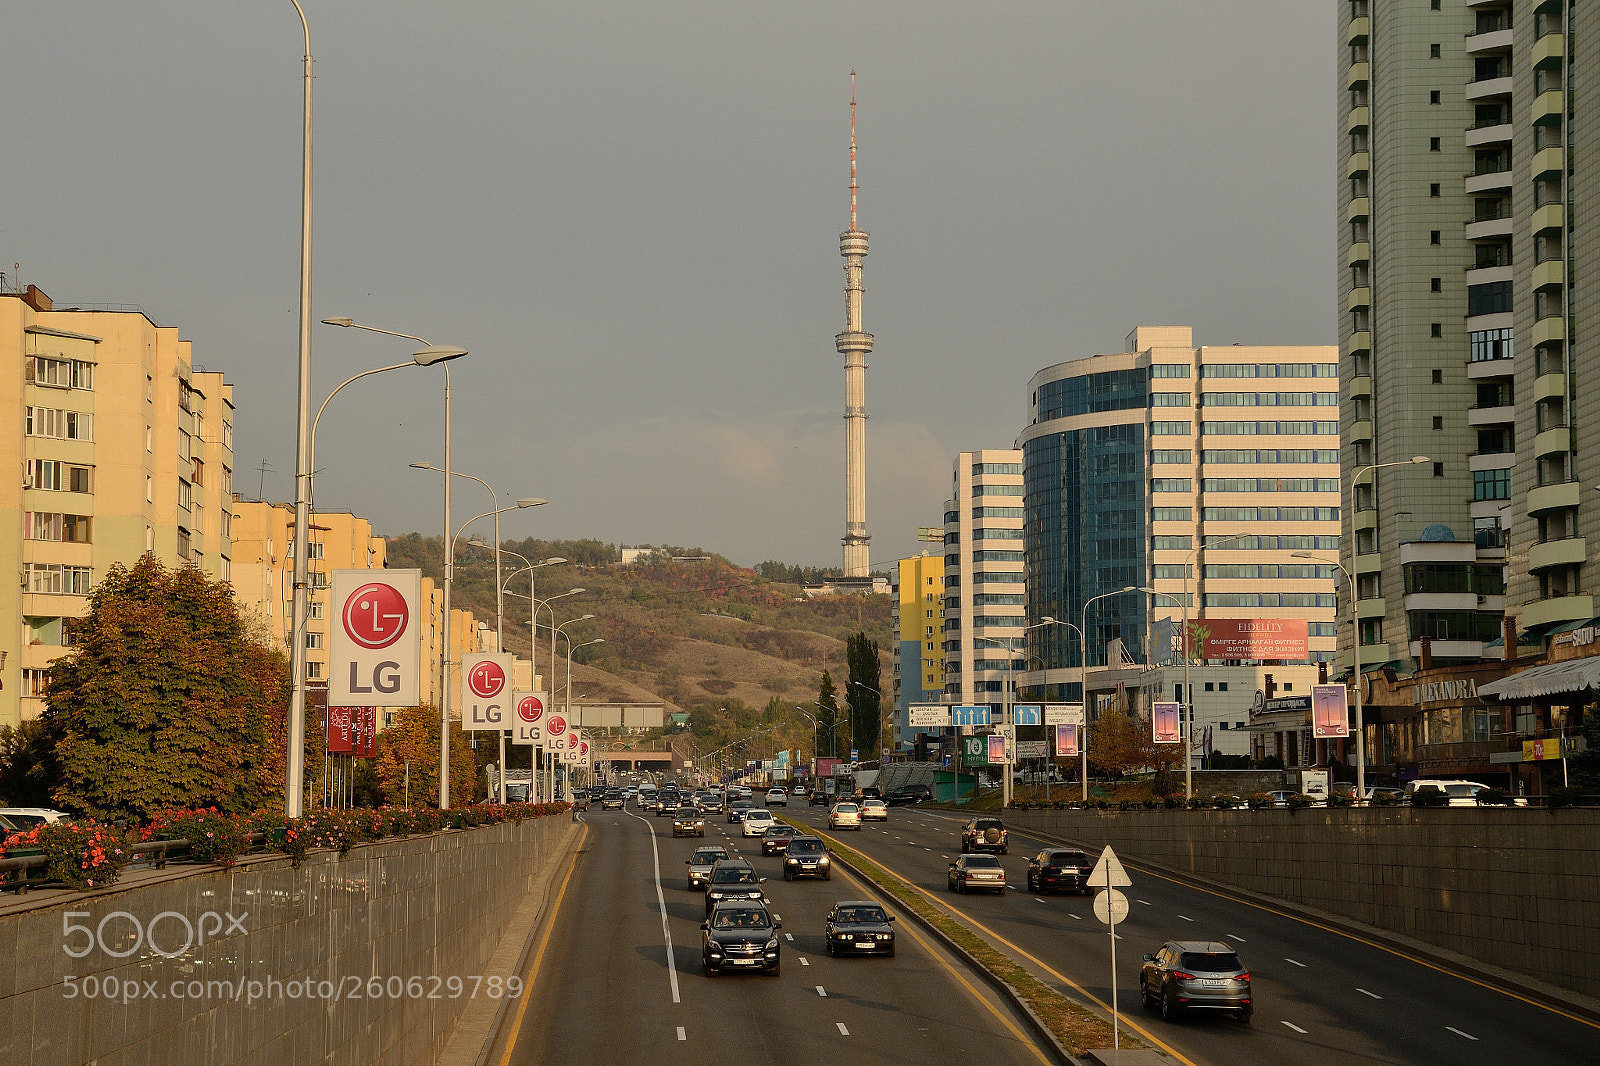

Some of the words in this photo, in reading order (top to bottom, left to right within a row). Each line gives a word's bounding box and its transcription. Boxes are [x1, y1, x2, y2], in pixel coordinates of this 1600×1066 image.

[350, 661, 400, 694] LG
[473, 704, 502, 723] LG
[520, 727, 540, 740] LG
[548, 739, 564, 749] LG
[966, 738, 982, 755] 10
[563, 751, 577, 760] LG
